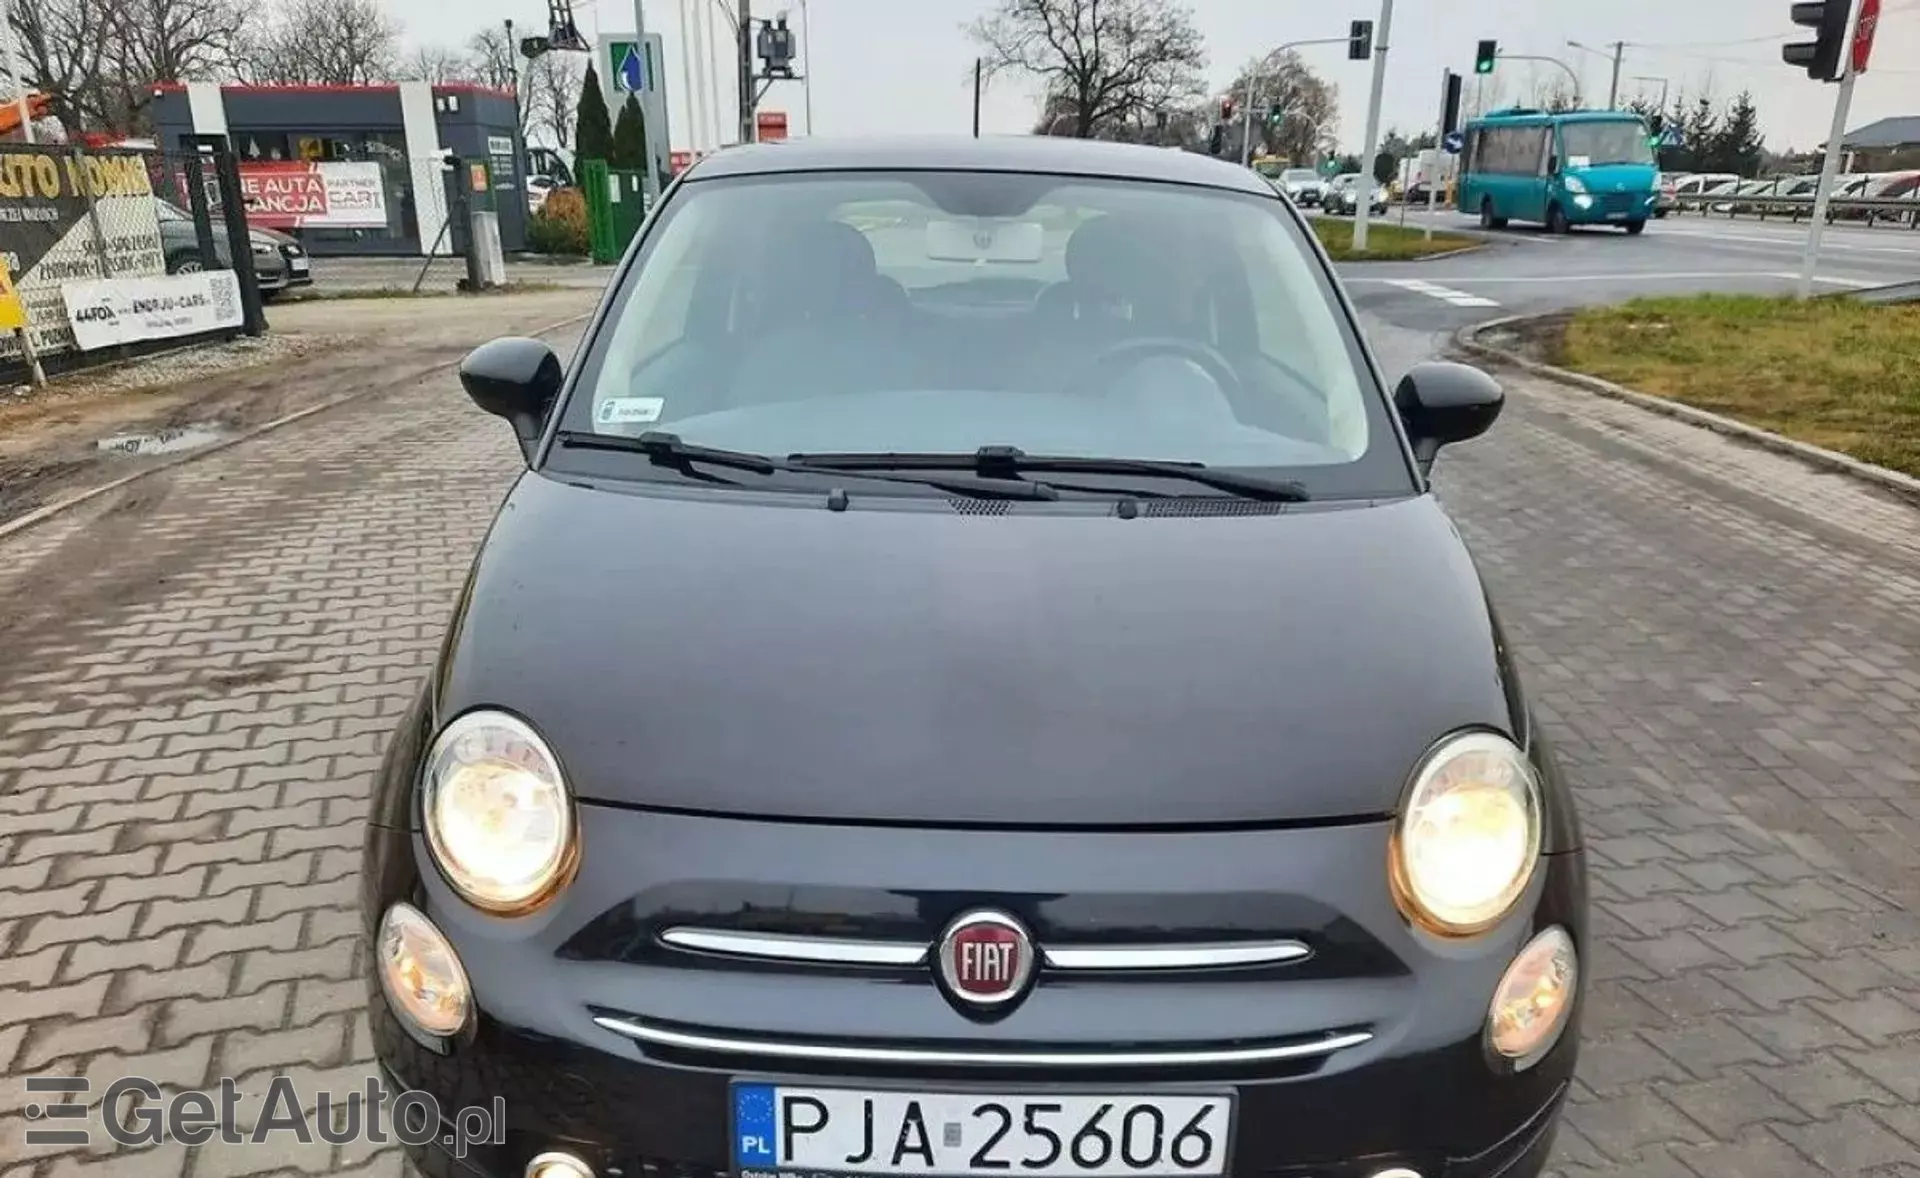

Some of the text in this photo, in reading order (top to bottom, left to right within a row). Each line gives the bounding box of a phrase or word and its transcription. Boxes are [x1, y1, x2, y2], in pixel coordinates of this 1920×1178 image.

[264, 178, 322, 193] AUTA
[961, 942, 1015, 981] FIAT
[742, 1136, 771, 1154] PL
[783, 1096, 1215, 1169] PJA 25606
